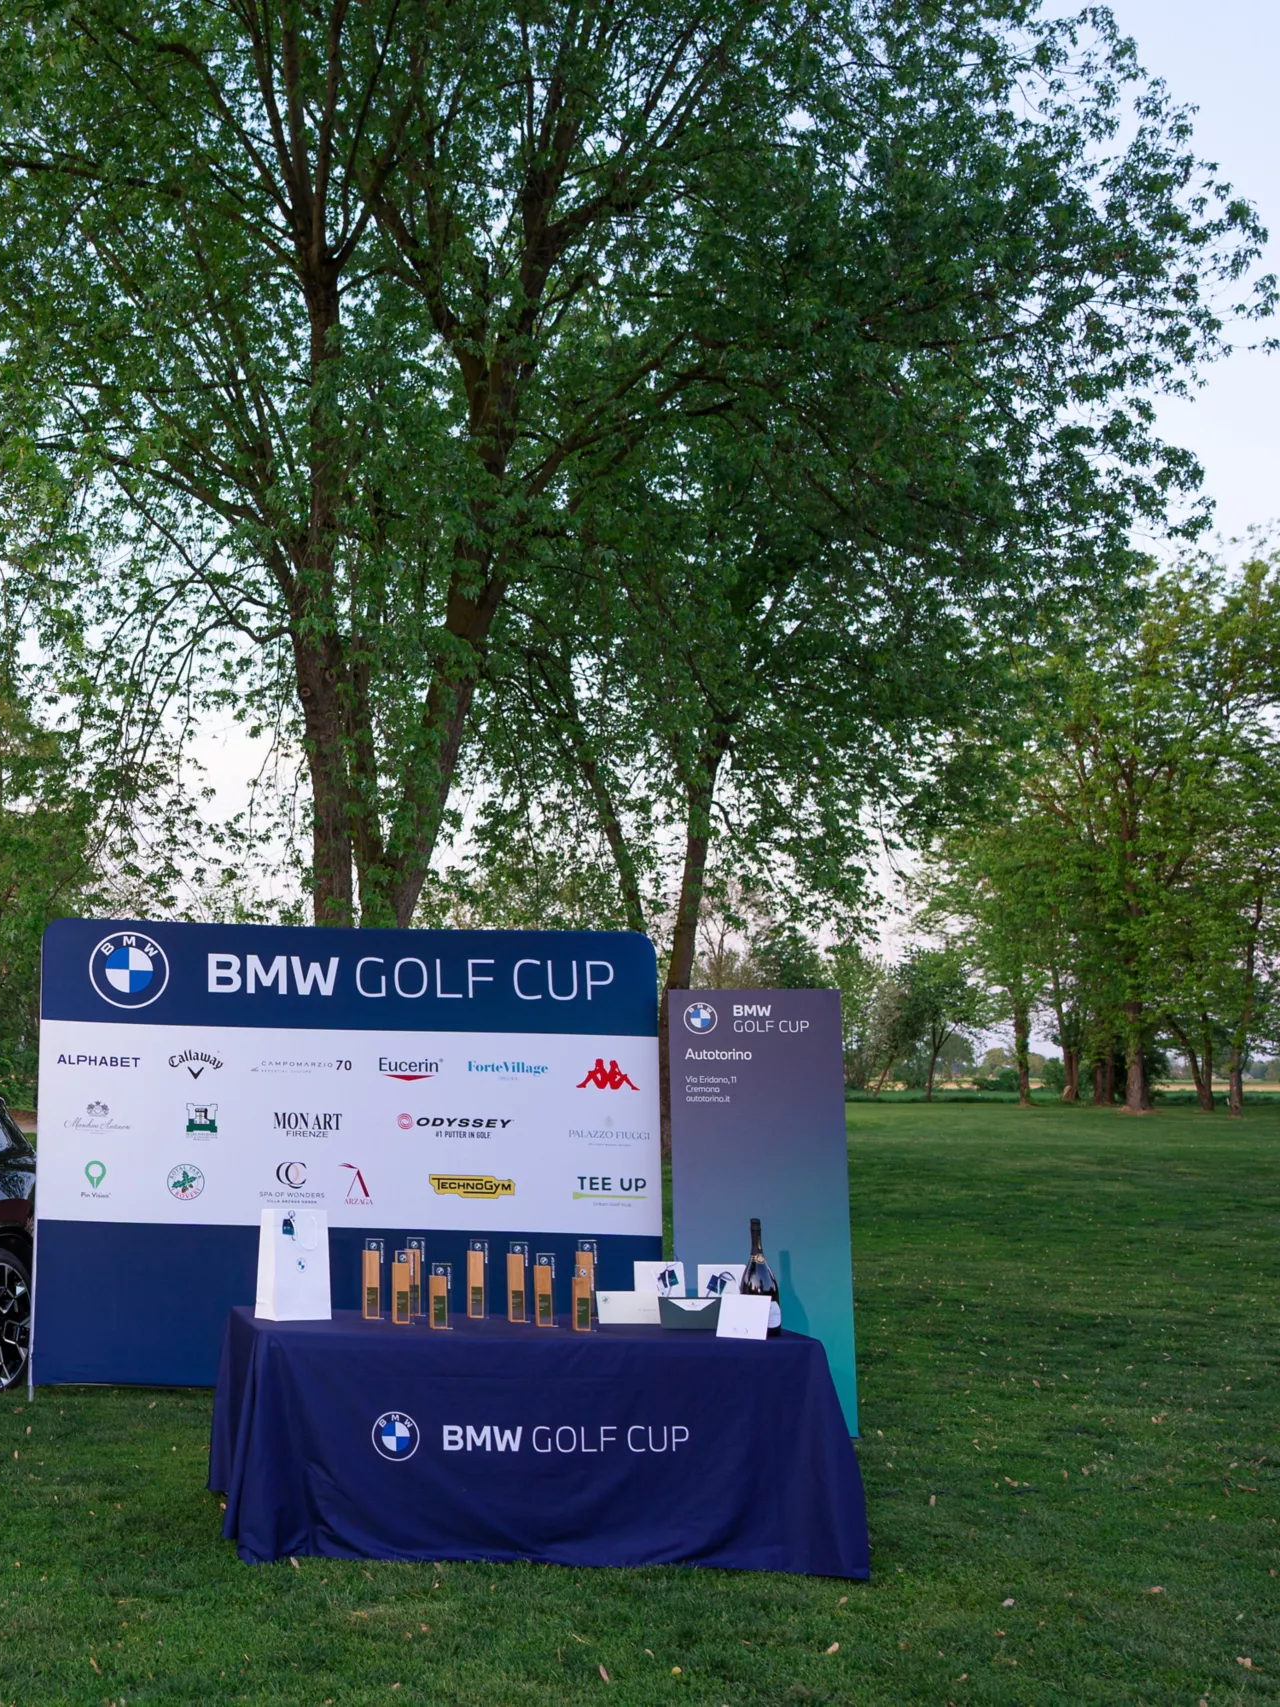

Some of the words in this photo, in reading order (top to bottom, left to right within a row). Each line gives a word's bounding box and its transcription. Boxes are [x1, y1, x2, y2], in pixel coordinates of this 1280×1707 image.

[100, 935, 158, 958] BMW
[207, 953, 340, 996] BMW
[355, 956, 495, 999] GOLF
[513, 958, 615, 1000] CUP
[733, 1004, 771, 1017] BMW
[733, 1020, 774, 1033] GOLF
[778, 1020, 810, 1033] CUP
[57, 1054, 141, 1068] ALPHABET
[168, 1049, 224, 1070] Callaway
[685, 1048, 752, 1061] Autotorino
[261, 1060, 334, 1068] CAMPOMARZIO
[336, 1060, 352, 1071] 70
[378, 1056, 439, 1073] Eucerin
[468, 1061, 549, 1077] ForteVillage
[685, 1085, 720, 1093] Cremona
[686, 1095, 730, 1103] autotorino.it
[416, 1117, 512, 1128] ODYSSEY
[286, 1130, 329, 1138] FIRENZE
[568, 1130, 613, 1139] PALAZZO
[616, 1131, 650, 1140] FIUGGI
[577, 1176, 612, 1191] TEE
[620, 1177, 647, 1192] UP
[378, 1414, 413, 1428] BMW
[442, 1425, 522, 1452] BMW
[532, 1426, 617, 1452] GOLF
[627, 1426, 689, 1452] CUP
